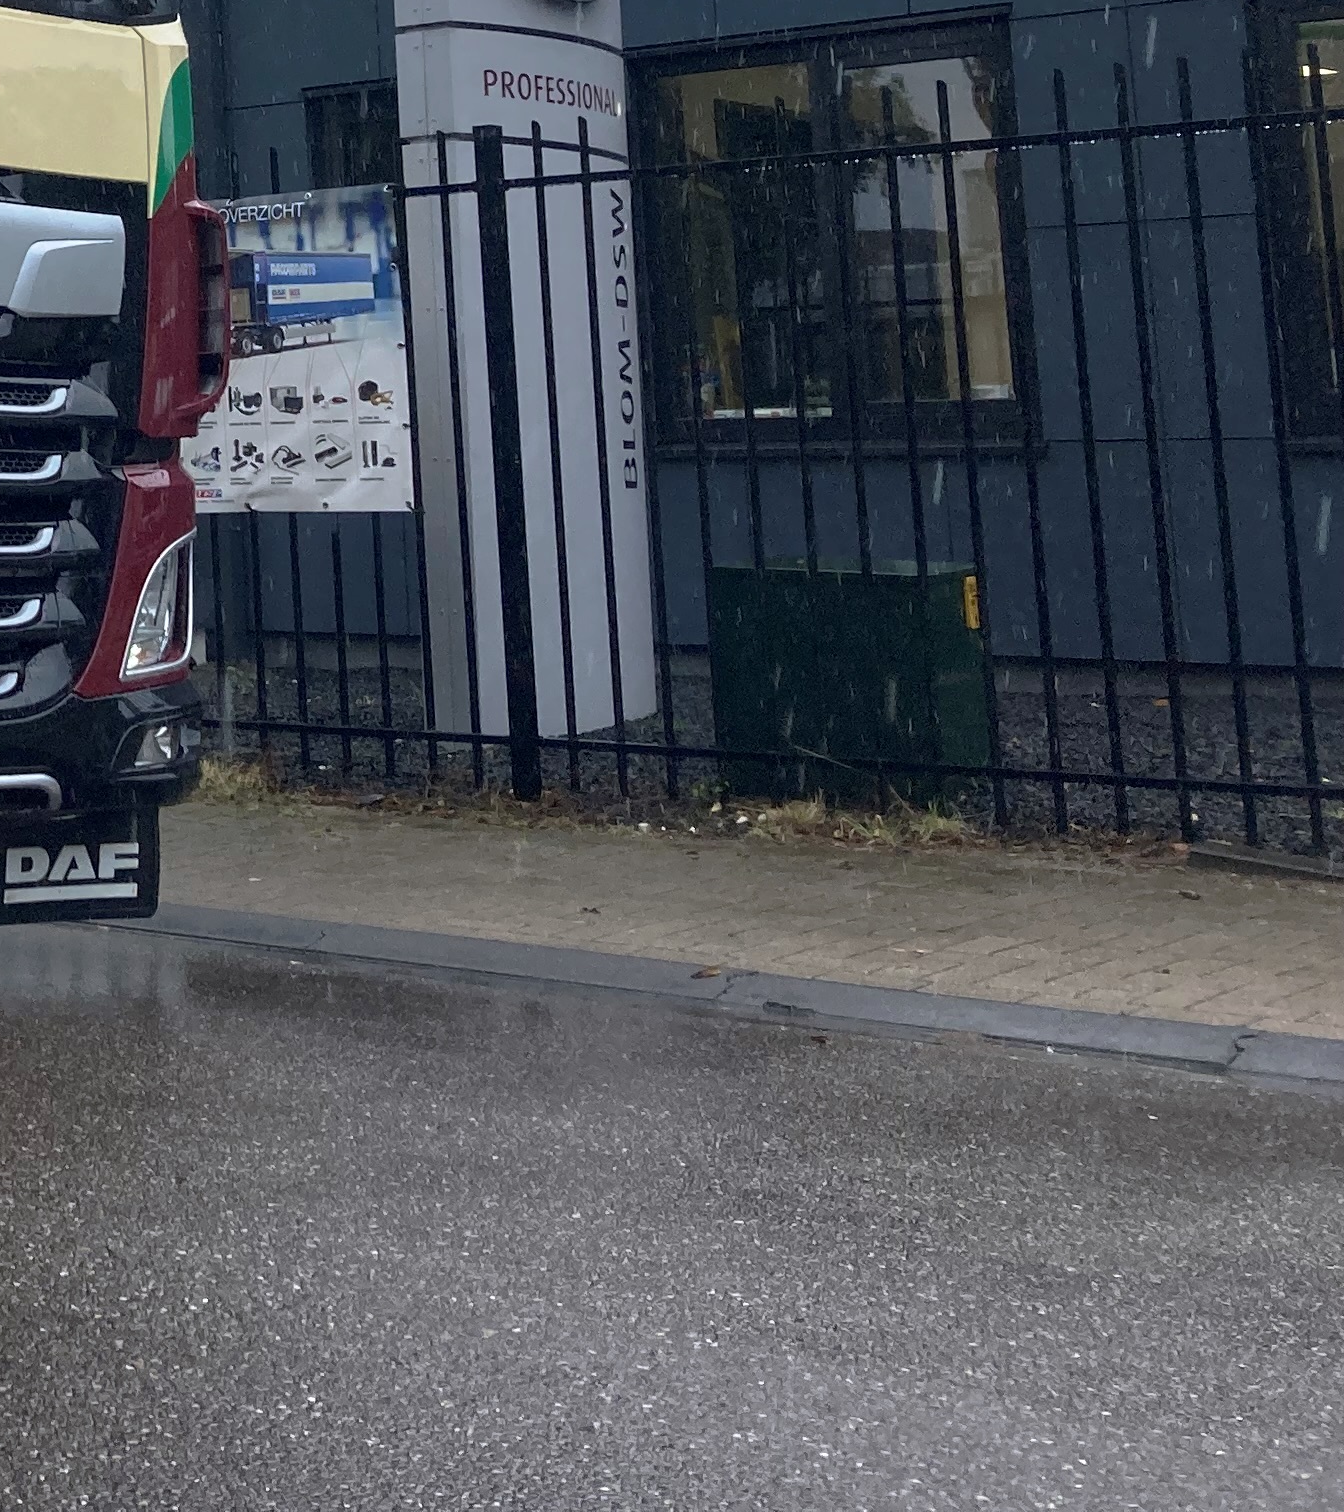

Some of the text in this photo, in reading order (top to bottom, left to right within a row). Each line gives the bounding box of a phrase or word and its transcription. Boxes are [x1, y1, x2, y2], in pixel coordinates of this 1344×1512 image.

[484, 68, 620, 117] PROFESSIONAL
[609, 188, 638, 489] BLOM-DSW
[4, 841, 141, 886] DAF
